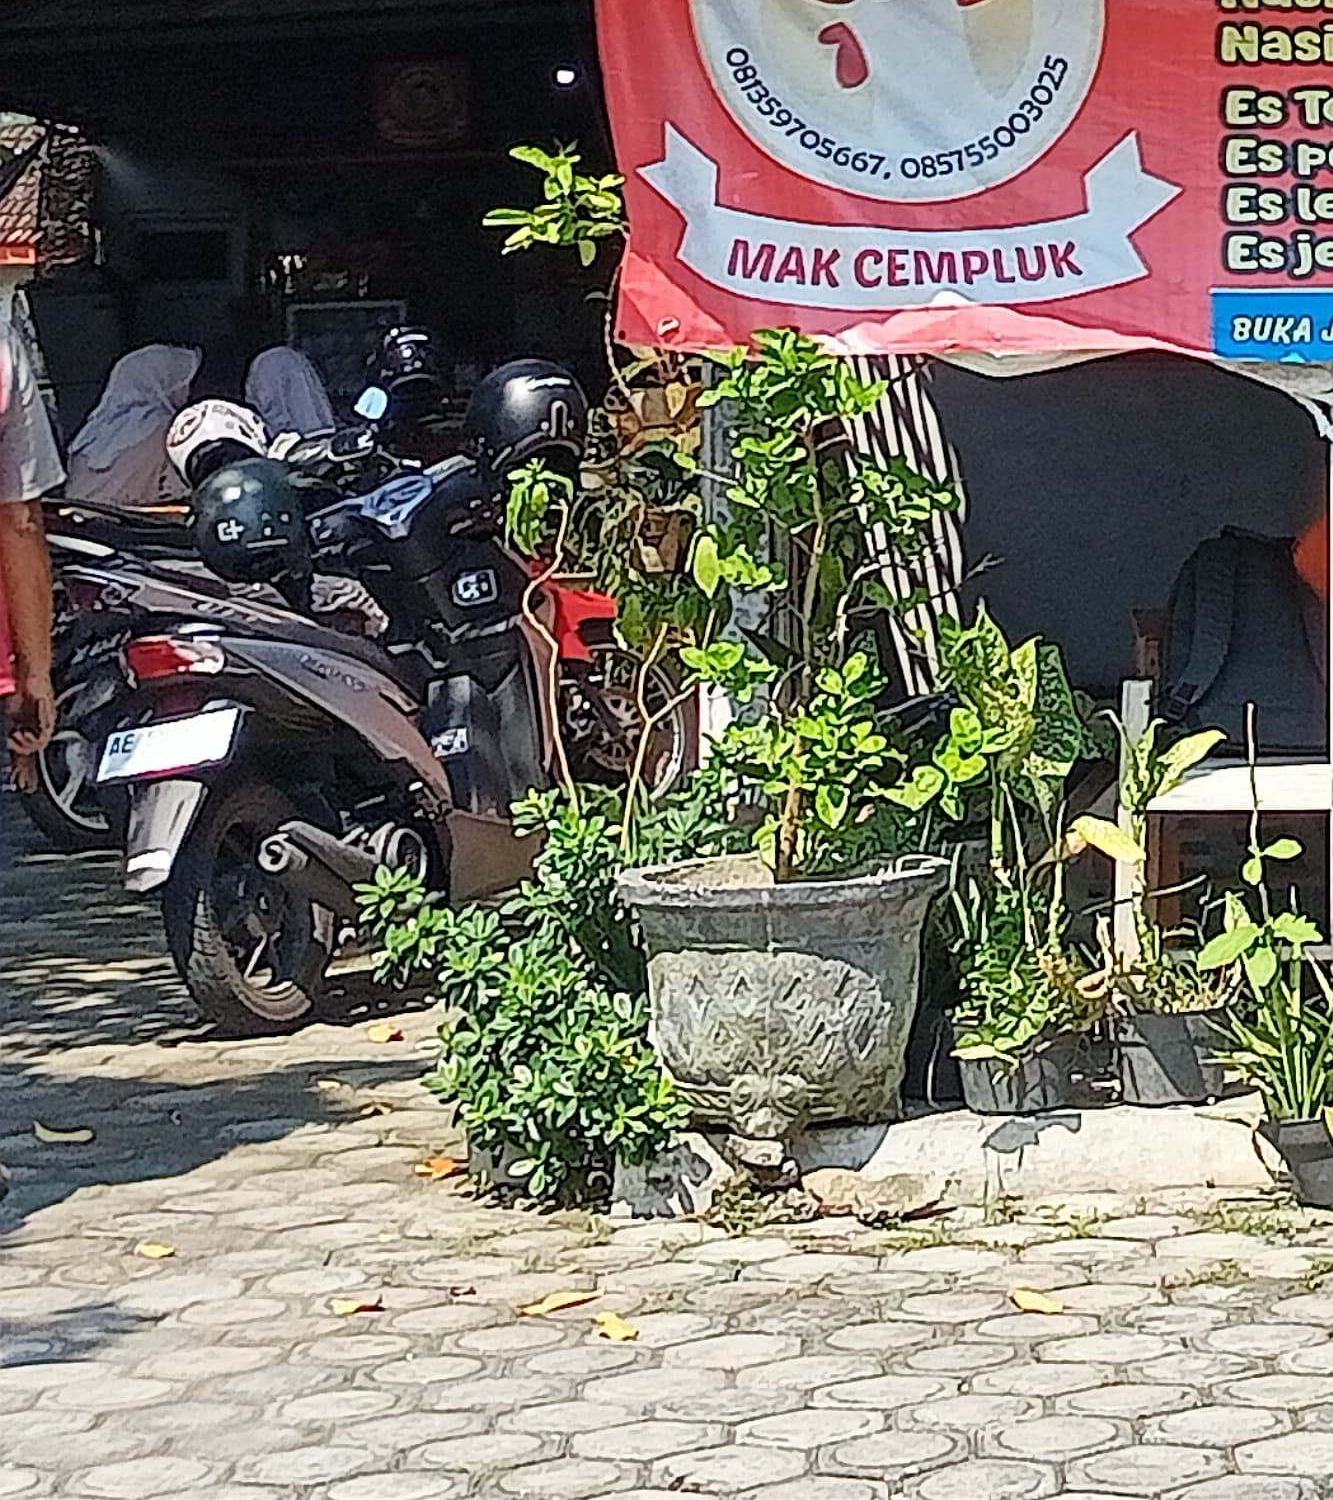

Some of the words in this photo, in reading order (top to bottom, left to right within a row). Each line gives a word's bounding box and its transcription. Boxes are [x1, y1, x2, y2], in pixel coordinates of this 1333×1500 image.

[900, 54, 1070, 182] 085755003025
[1225, 90, 1283, 125] Es
[1225, 138, 1283, 174] Es
[1226, 187, 1283, 222] Es
[727, 238, 841, 290] MAK
[853, 241, 1084, 289] CEMPLUK
[1227, 235, 1284, 270] Es
[1232, 316, 1311, 344] BUKA
